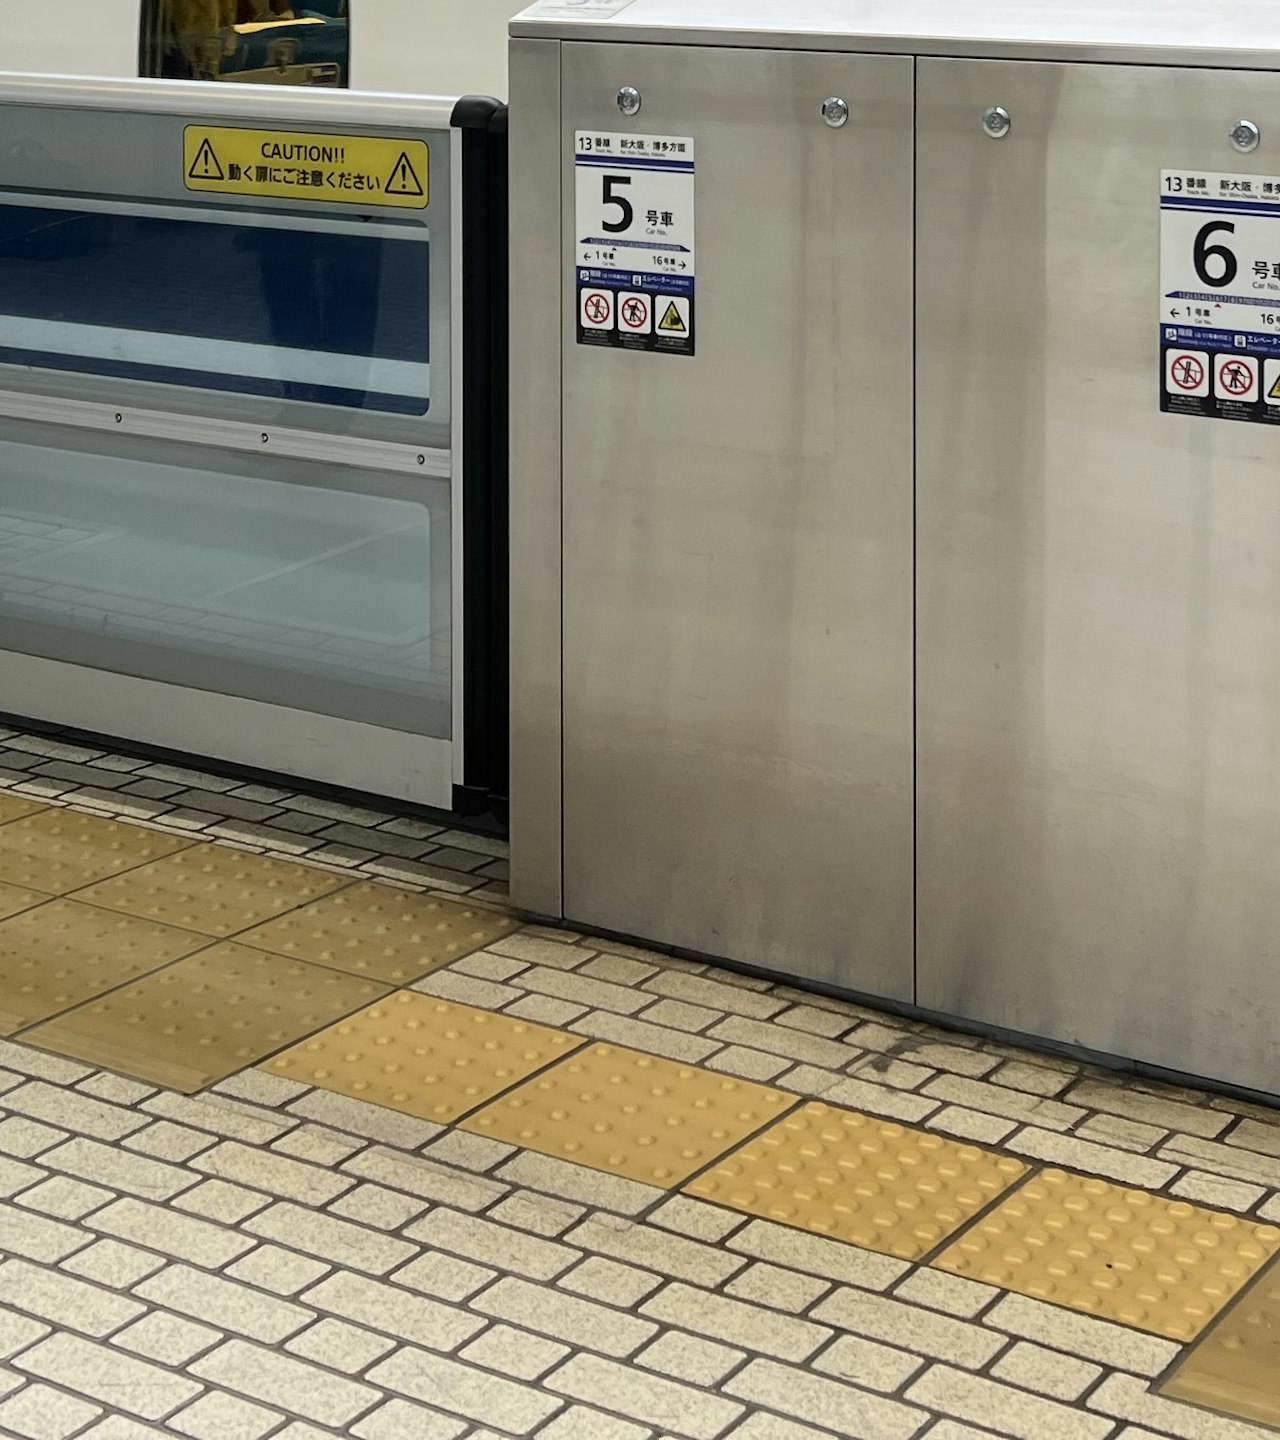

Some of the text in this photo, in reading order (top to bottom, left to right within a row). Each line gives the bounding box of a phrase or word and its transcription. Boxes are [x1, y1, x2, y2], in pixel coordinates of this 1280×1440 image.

[261, 142, 345, 164] CAUTION!!
[228, 163, 381, 190] 動く扉にご注意ください
[602, 174, 674, 233] 5 号車
[1193, 220, 1237, 288] 6
[1252, 281, 1280, 291] Car No.
